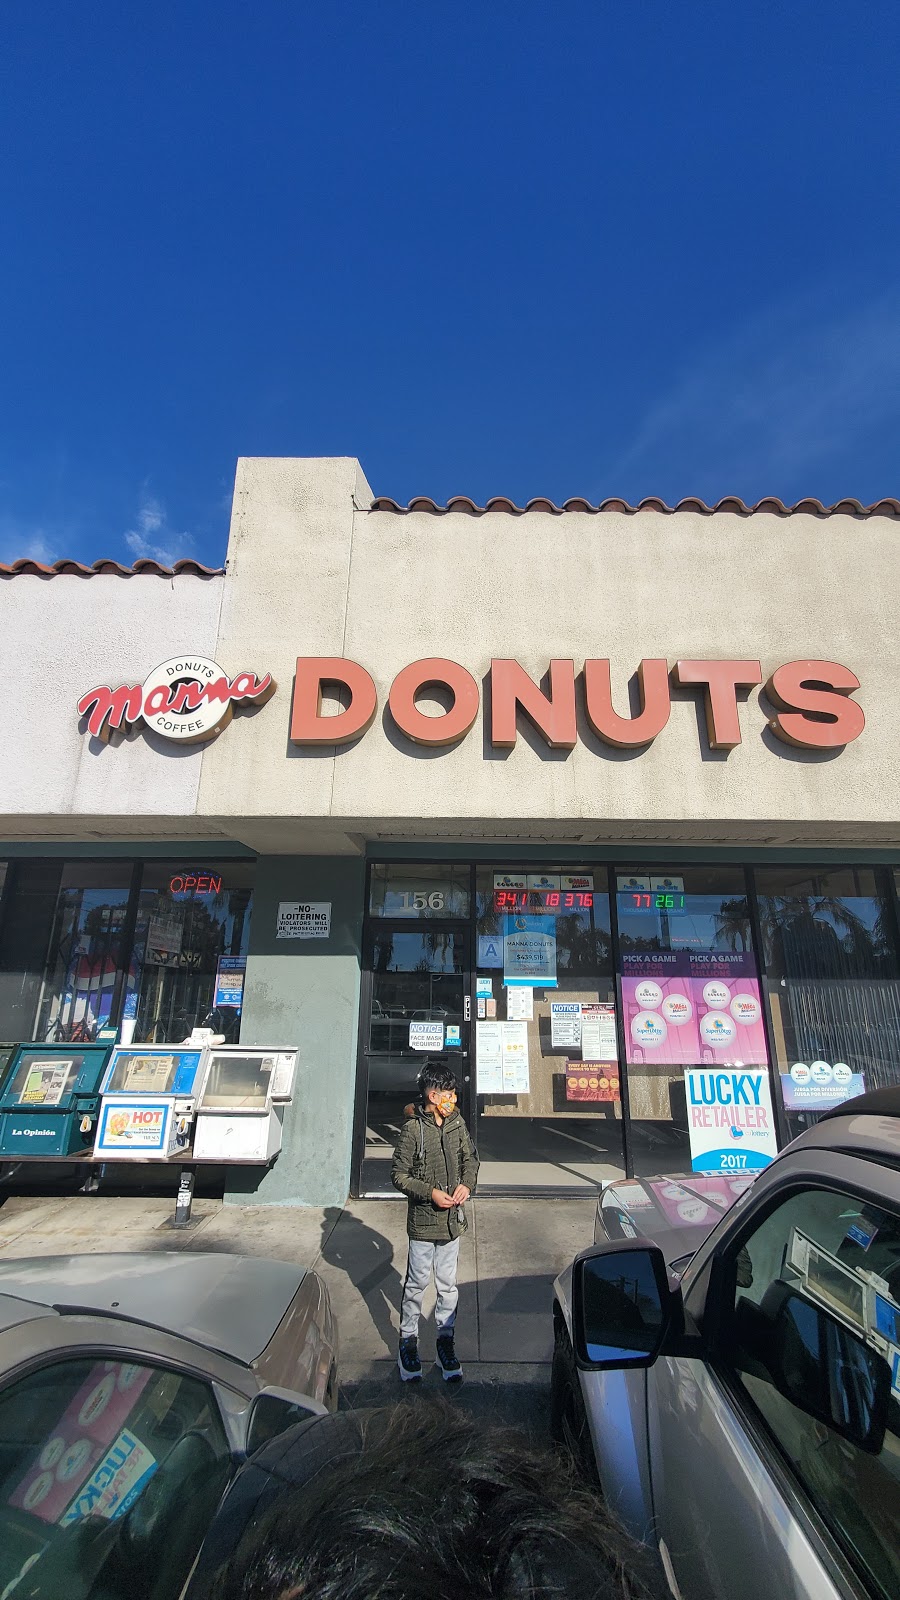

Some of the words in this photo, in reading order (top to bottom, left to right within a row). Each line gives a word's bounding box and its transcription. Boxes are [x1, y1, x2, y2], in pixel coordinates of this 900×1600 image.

[166, 662, 214, 678] DONUTS
[290, 656, 866, 748] DONUTS
[156, 717, 204, 733] COFFEE
[169, 876, 222, 894] OPEN
[399, 891, 445, 910] 156
[497, 891, 527, 906] 341
[545, 893, 560, 907] 18
[564, 893, 593, 907] 376
[632, 894, 651, 908] 77
[655, 894, 684, 908] 261
[281, 913, 327, 921] LOITERING
[485, 943, 498, 957] A
[651, 955, 677, 963] GAME
[717, 955, 744, 963] GAME
[411, 1024, 442, 1033] NOTICE
[688, 1074, 762, 1105] LUCKY
[132, 1111, 163, 1124] HOT
[691, 1106, 769, 1128] RETAILER
[720, 1154, 747, 1168] 2017
